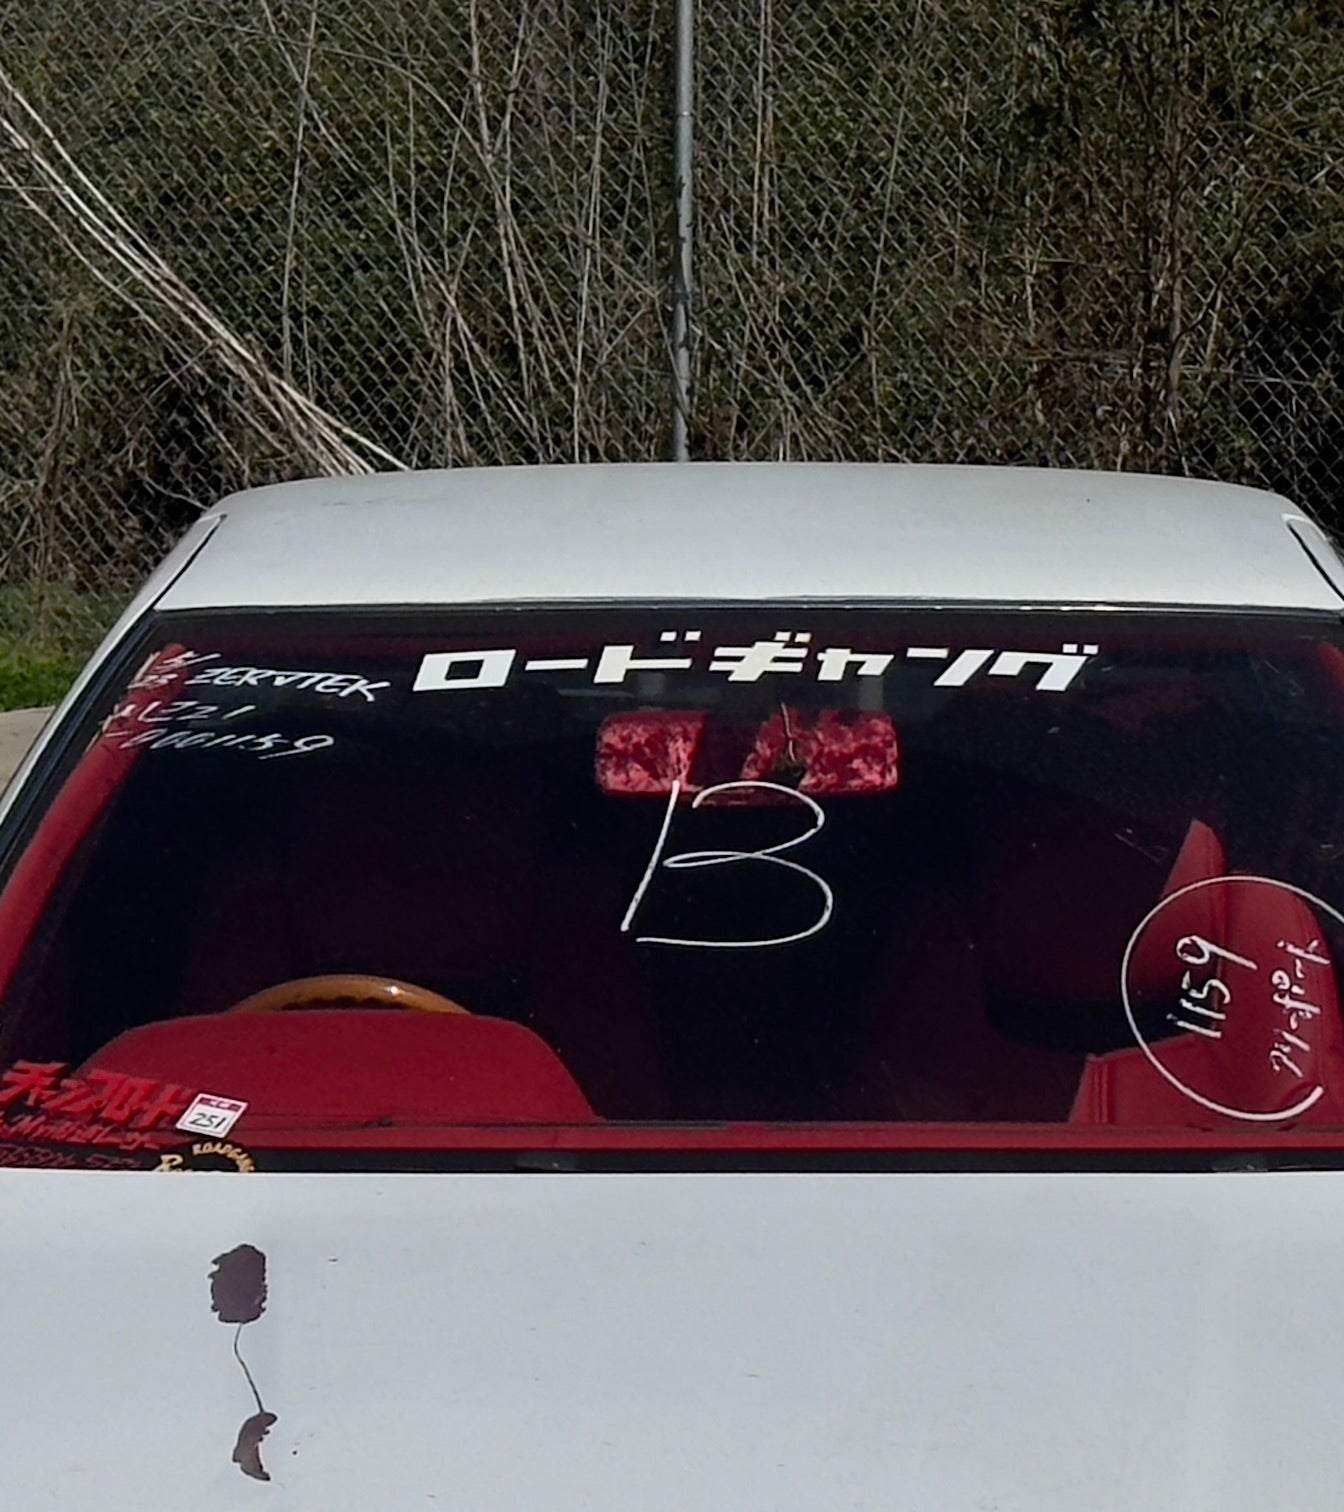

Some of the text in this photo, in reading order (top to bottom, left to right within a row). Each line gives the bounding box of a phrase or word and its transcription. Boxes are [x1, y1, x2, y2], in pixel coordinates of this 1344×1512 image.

[413, 630, 1099, 692] ロードギャング
[1165, 934, 1258, 1039] 1159
[188, 1112, 227, 1129] 251
